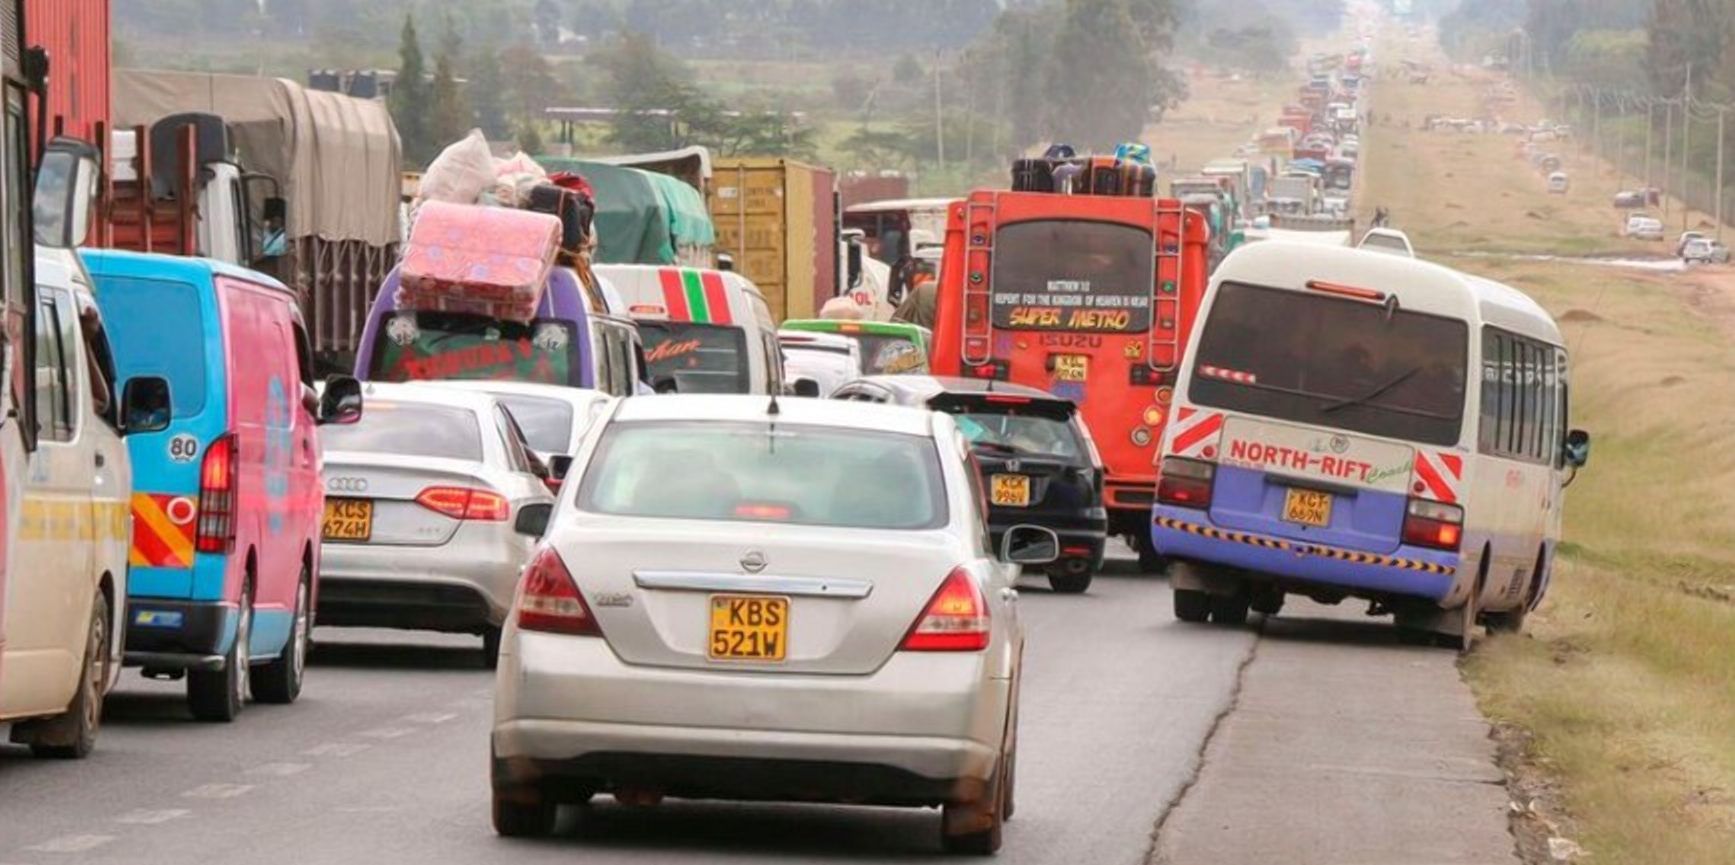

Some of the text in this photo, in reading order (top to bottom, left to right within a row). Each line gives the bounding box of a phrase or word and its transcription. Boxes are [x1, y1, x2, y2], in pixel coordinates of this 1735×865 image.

[1009, 306, 1130, 330] SUPER METRO
[1039, 334, 1102, 348] ISUZU
[171, 438, 197, 456] 80
[1230, 439, 1372, 481] NORTH-RIFT
[332, 502, 369, 518] KCS
[323, 520, 367, 536] 674H
[729, 601, 781, 626] KBS
[713, 630, 779, 656] 521W
